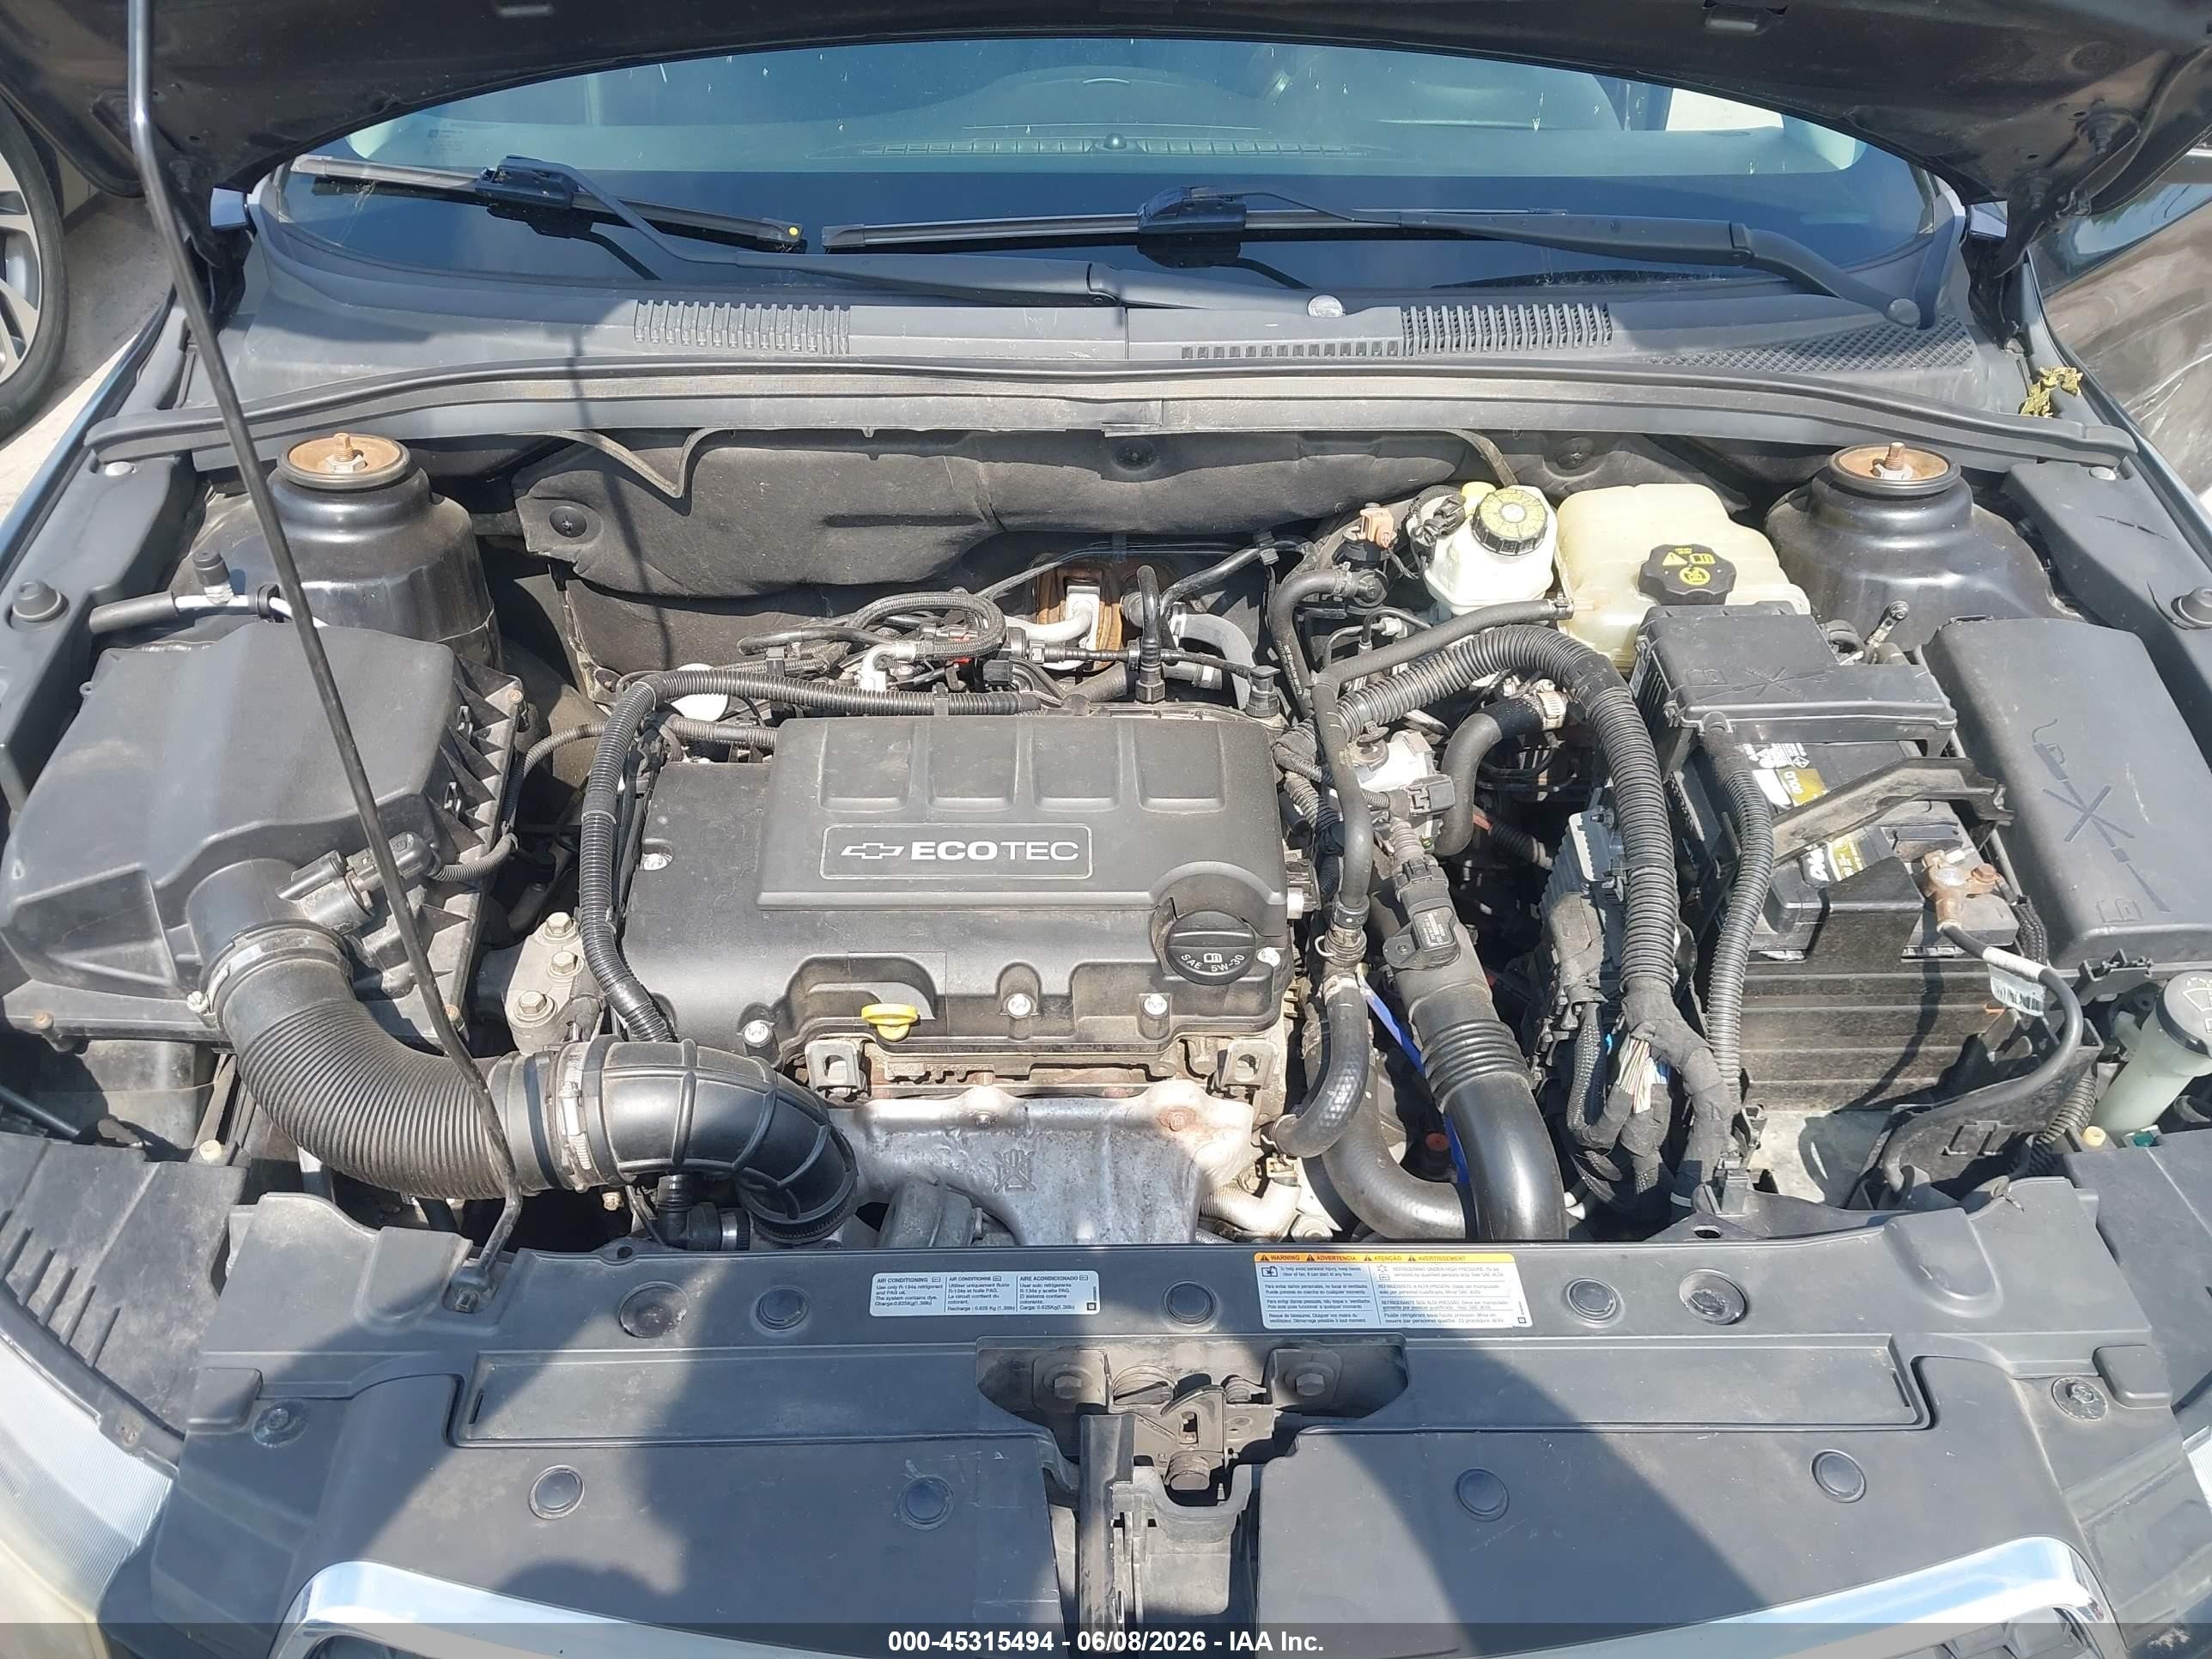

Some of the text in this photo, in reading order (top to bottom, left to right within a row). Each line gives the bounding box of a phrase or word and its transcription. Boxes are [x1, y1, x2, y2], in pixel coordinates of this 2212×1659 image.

[911, 841, 1079, 860] ECOTEC
[1181, 954, 1245, 972] SAE 5W-30
